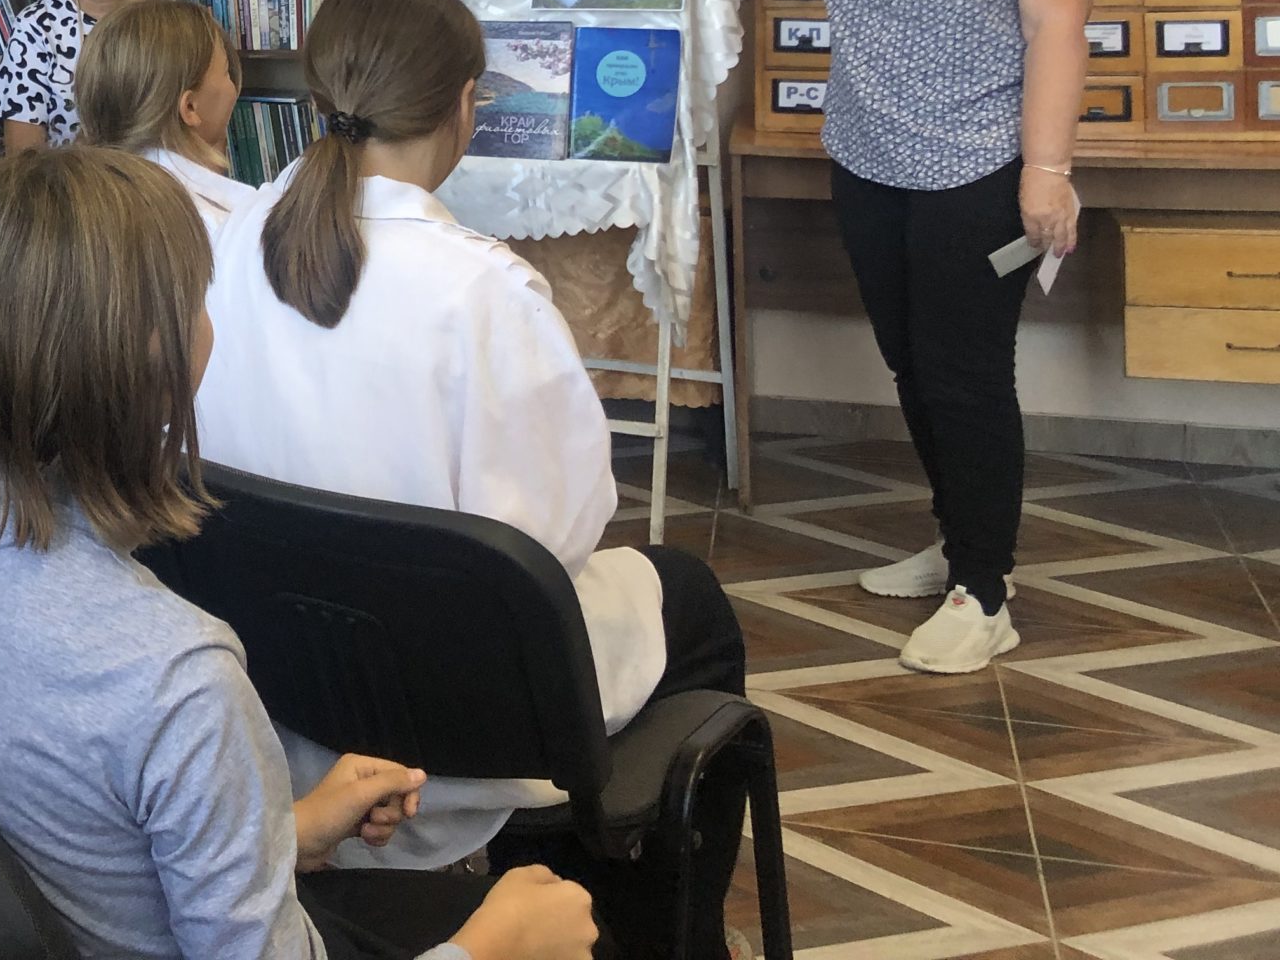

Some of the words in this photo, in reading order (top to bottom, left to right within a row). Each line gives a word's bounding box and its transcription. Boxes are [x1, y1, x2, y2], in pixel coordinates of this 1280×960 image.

[787, 27, 821, 41] КП
[786, 86, 819, 101] Р-С
[500, 115, 535, 128] КРАЙ
[504, 132, 530, 145] ГОР
